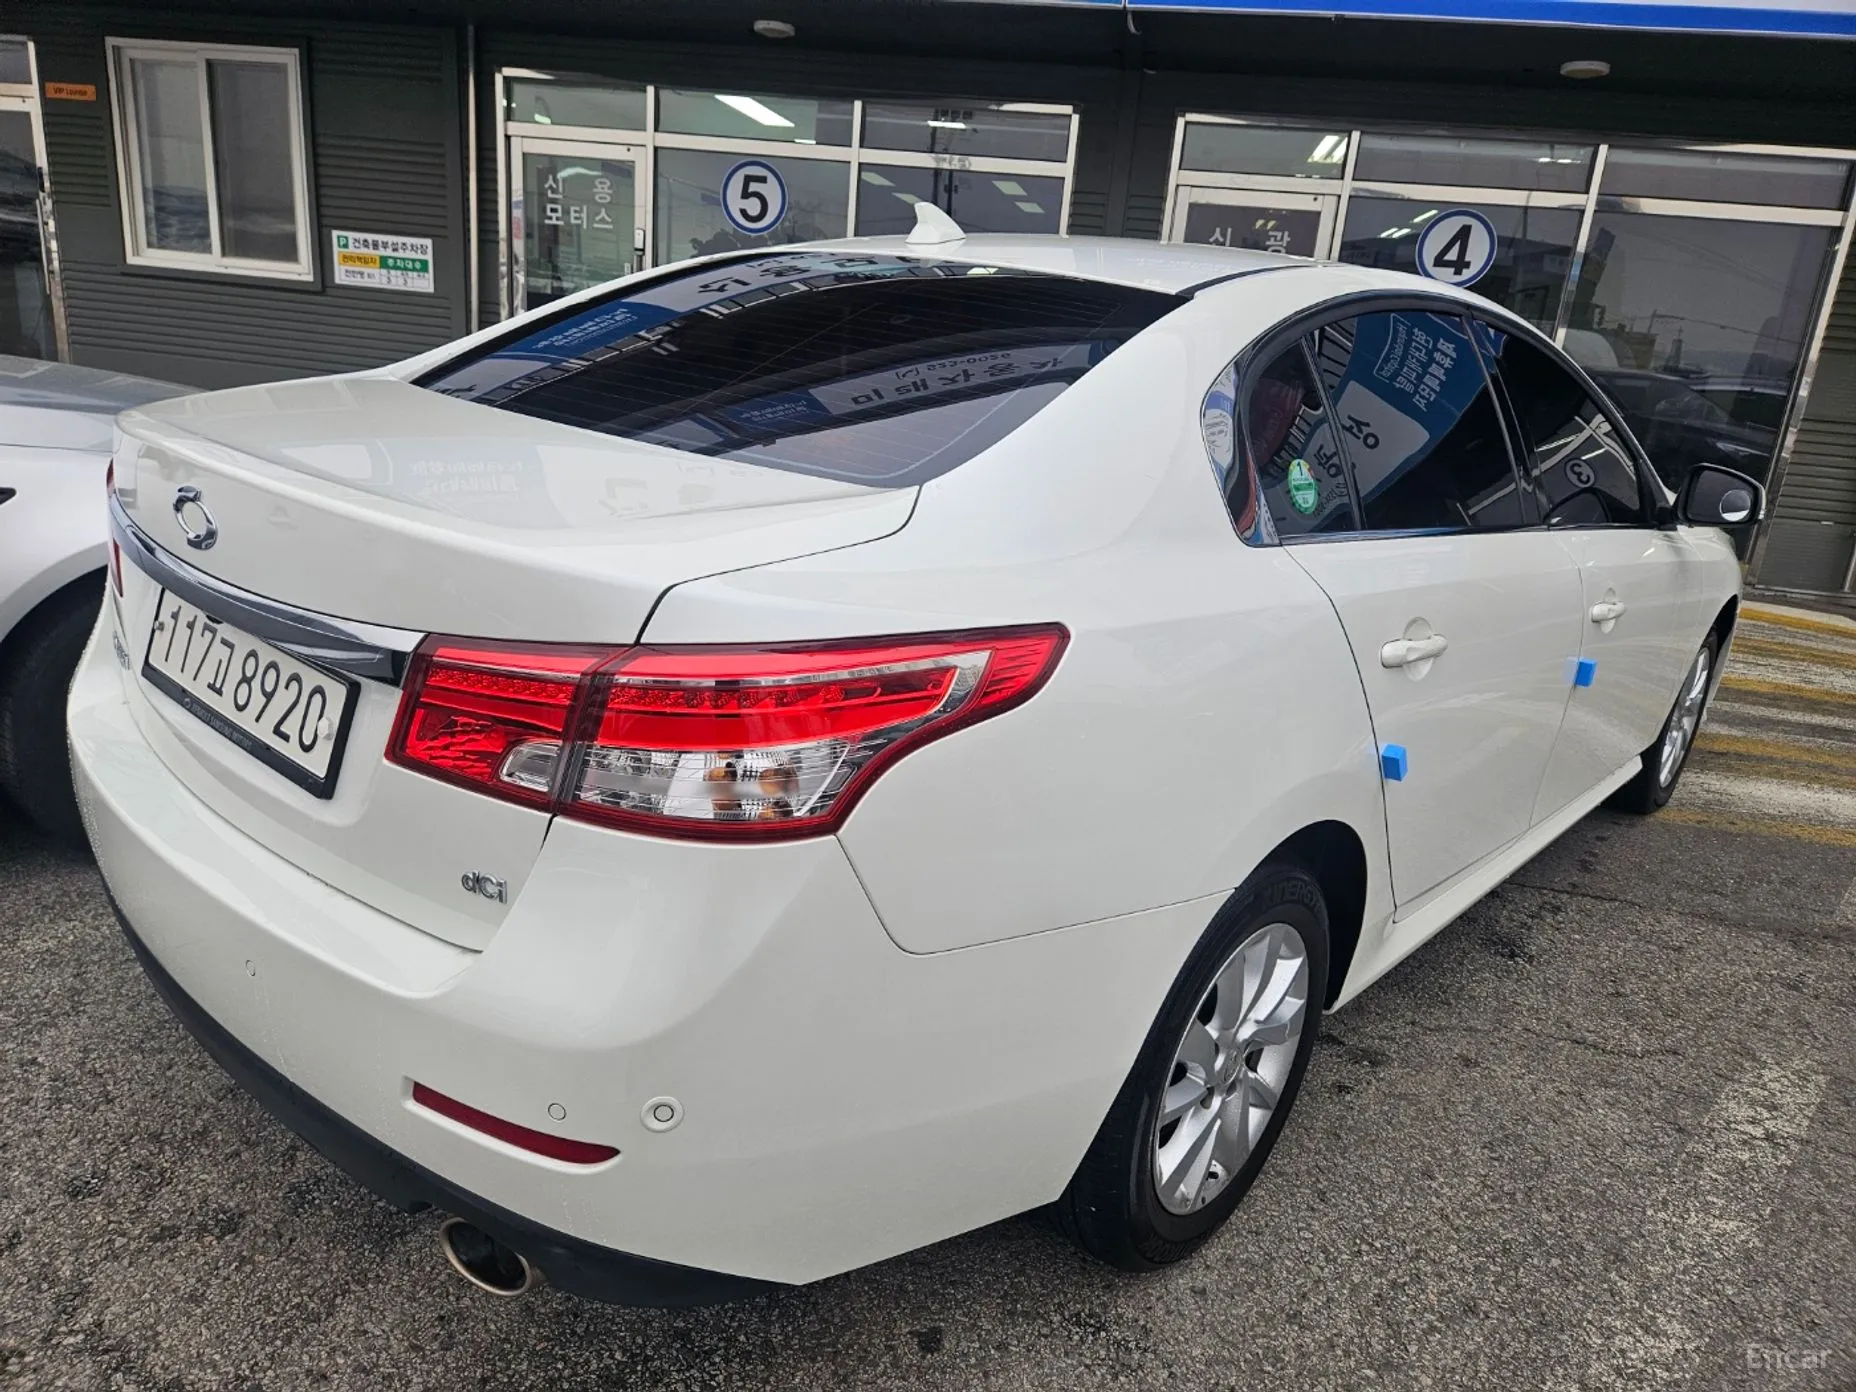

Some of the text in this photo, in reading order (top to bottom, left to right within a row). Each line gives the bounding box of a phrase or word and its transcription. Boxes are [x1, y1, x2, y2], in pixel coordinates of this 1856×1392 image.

[544, 203, 613, 229] 모터스
[738, 173, 769, 224] 5
[1432, 224, 1474, 276] 4
[164, 605, 327, 753] 117고8920
[461, 870, 508, 904] dCi
